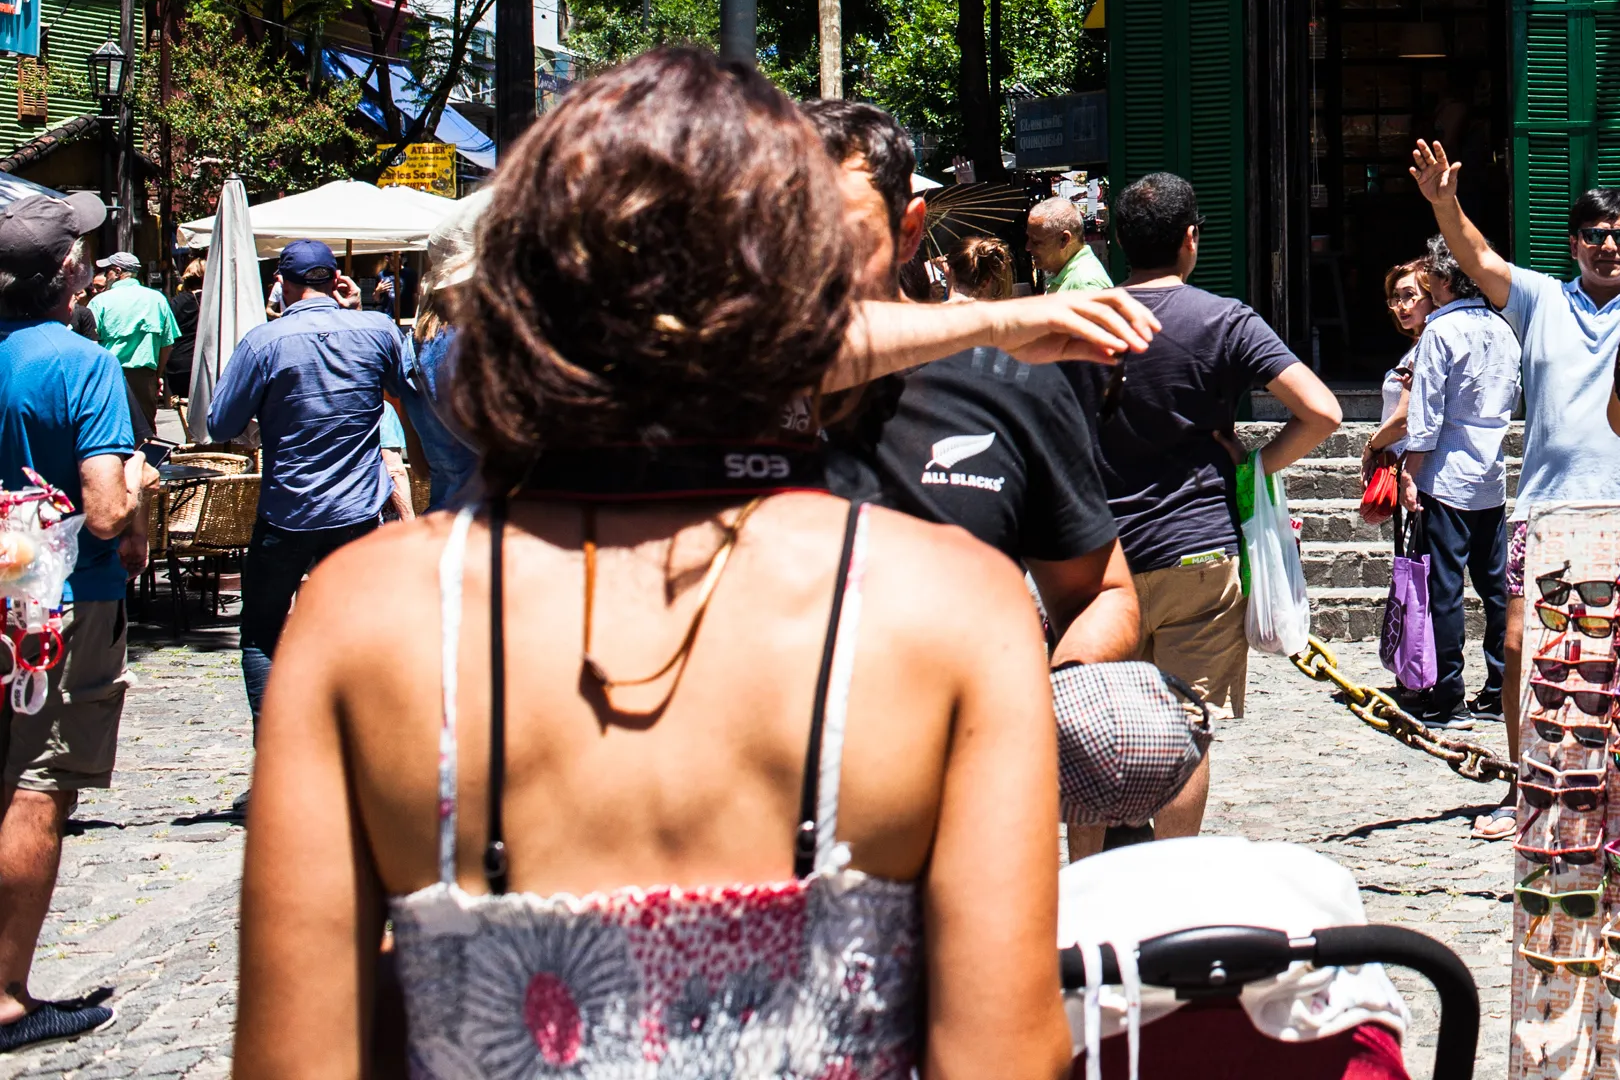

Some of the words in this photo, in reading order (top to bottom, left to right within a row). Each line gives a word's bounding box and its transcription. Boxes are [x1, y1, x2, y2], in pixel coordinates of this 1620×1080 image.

[411, 146, 445, 154] ATELIER
[413, 170, 437, 179] Sosa
[725, 454, 790, 478] EOS
[922, 472, 949, 484] ALL
